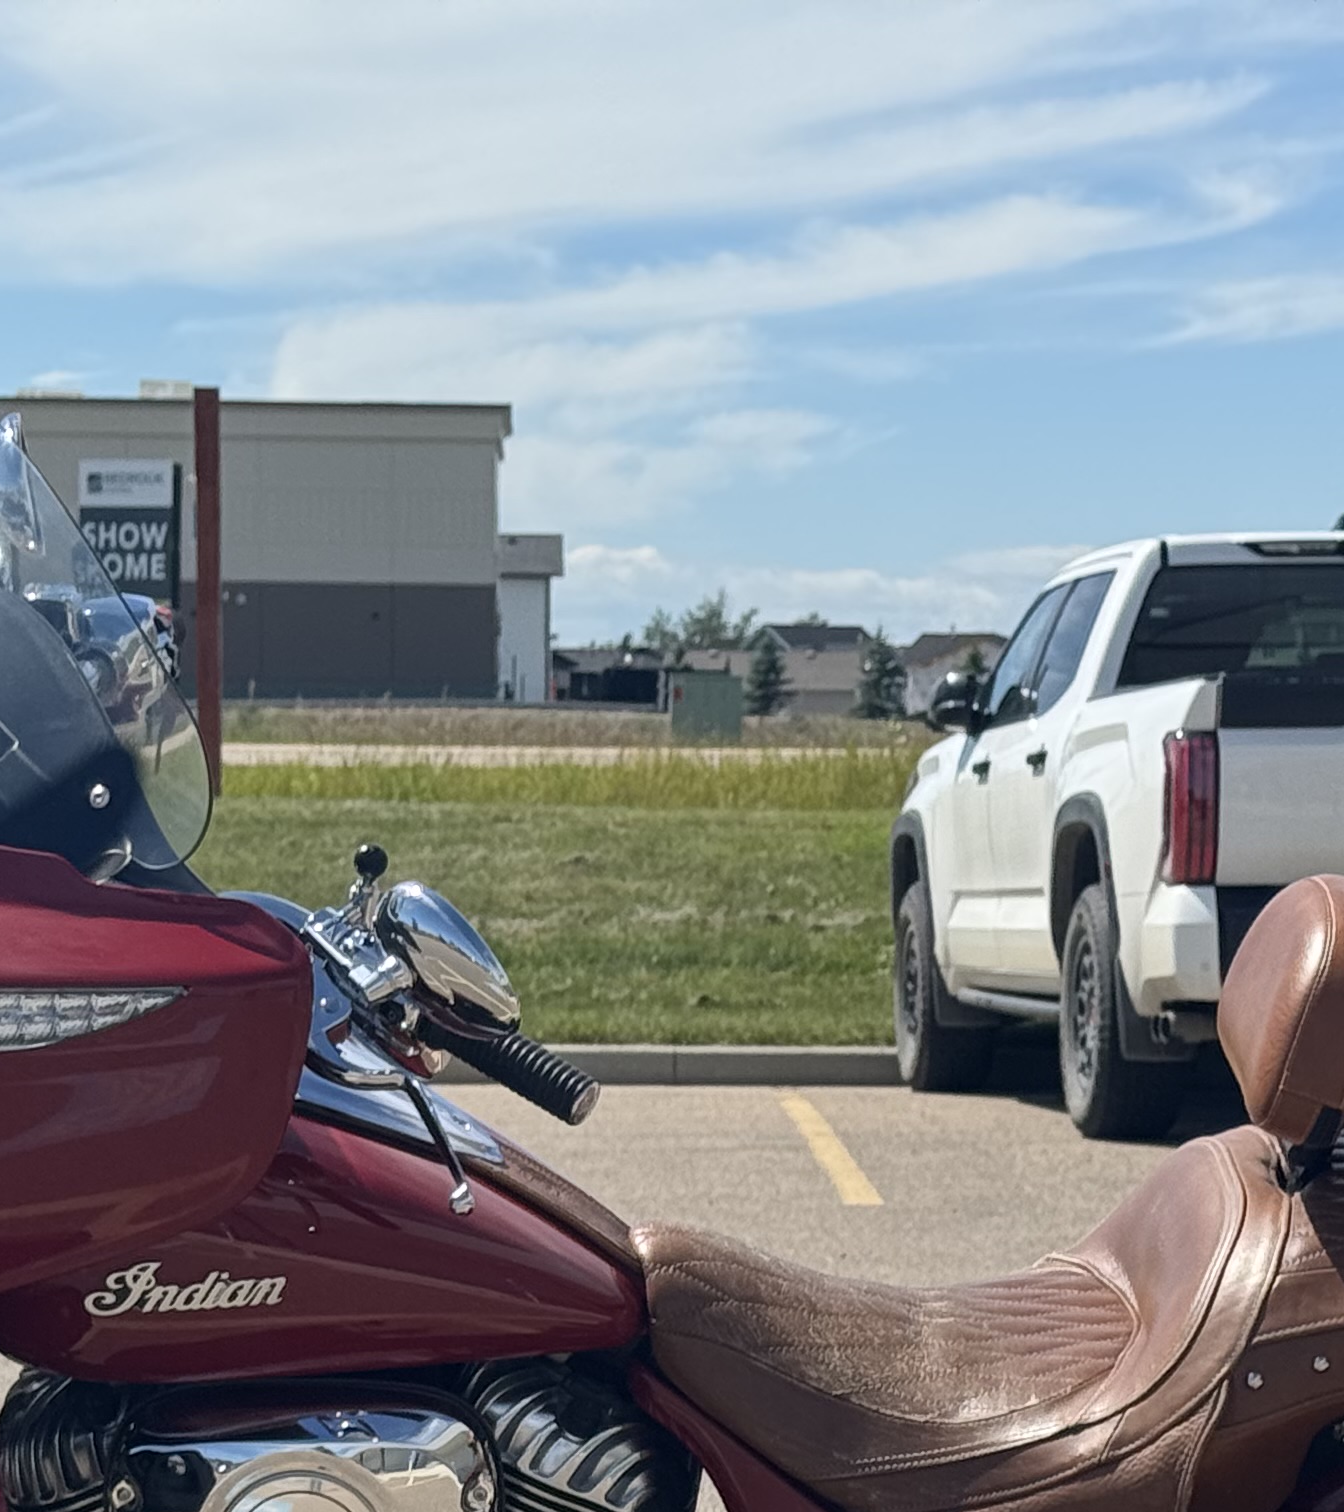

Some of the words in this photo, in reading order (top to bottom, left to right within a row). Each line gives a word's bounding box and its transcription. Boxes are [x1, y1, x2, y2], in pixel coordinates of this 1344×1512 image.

[82, 521, 168, 550] SHOW
[96, 551, 167, 581] OME
[83, 1261, 287, 1317] Indian
